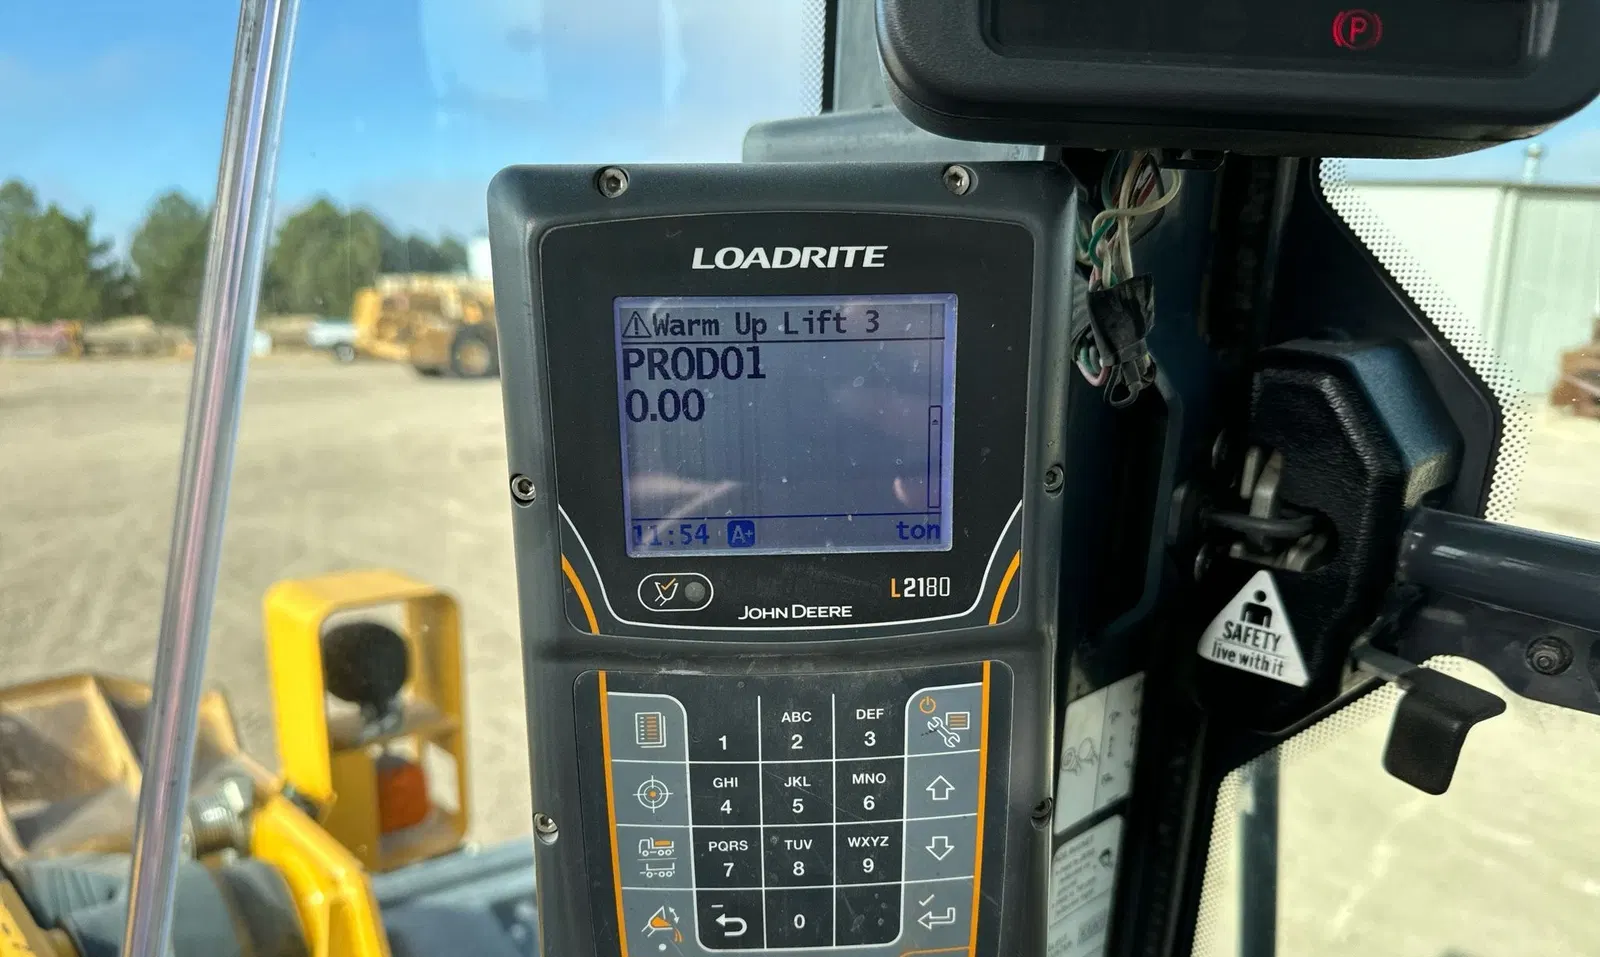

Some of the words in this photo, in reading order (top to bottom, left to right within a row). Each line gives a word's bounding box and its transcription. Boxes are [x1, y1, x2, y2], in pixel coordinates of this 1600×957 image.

[1350, 17, 1368, 43] P
[691, 245, 888, 270] LOADRITE
[652, 312, 720, 336] Warm
[735, 312, 768, 342] Up
[784, 310, 847, 335] Lift
[865, 310, 880, 333] 3
[625, 388, 706, 422] 0.00
[632, 523, 710, 546] 11:54
[896, 520, 941, 541] ton
[890, 576, 950, 598] L2180
[738, 605, 789, 620] JOHN
[792, 604, 853, 619] DEERE
[1222, 619, 1282, 652] SAFETY
[1211, 641, 1236, 662] live
[1239, 652, 1270, 672] with
[1272, 658, 1285, 676] it
[781, 712, 812, 722] ABC
[856, 709, 884, 720] DEF
[718, 735, 727, 750] 1
[791, 734, 803, 749] 2
[864, 731, 876, 746] 3
[713, 777, 738, 788] GHI
[784, 777, 811, 787] JKL
[852, 773, 886, 784] MNO
[720, 800, 732, 814] 4
[792, 799, 804, 813] 5
[863, 796, 875, 810] 6
[708, 840, 748, 852] PQRS
[784, 839, 812, 850] TUV
[848, 836, 889, 847] WXYZ
[724, 862, 734, 878] 7
[793, 861, 804, 876] 8
[862, 858, 874, 873] 9
[794, 914, 806, 929] 0
